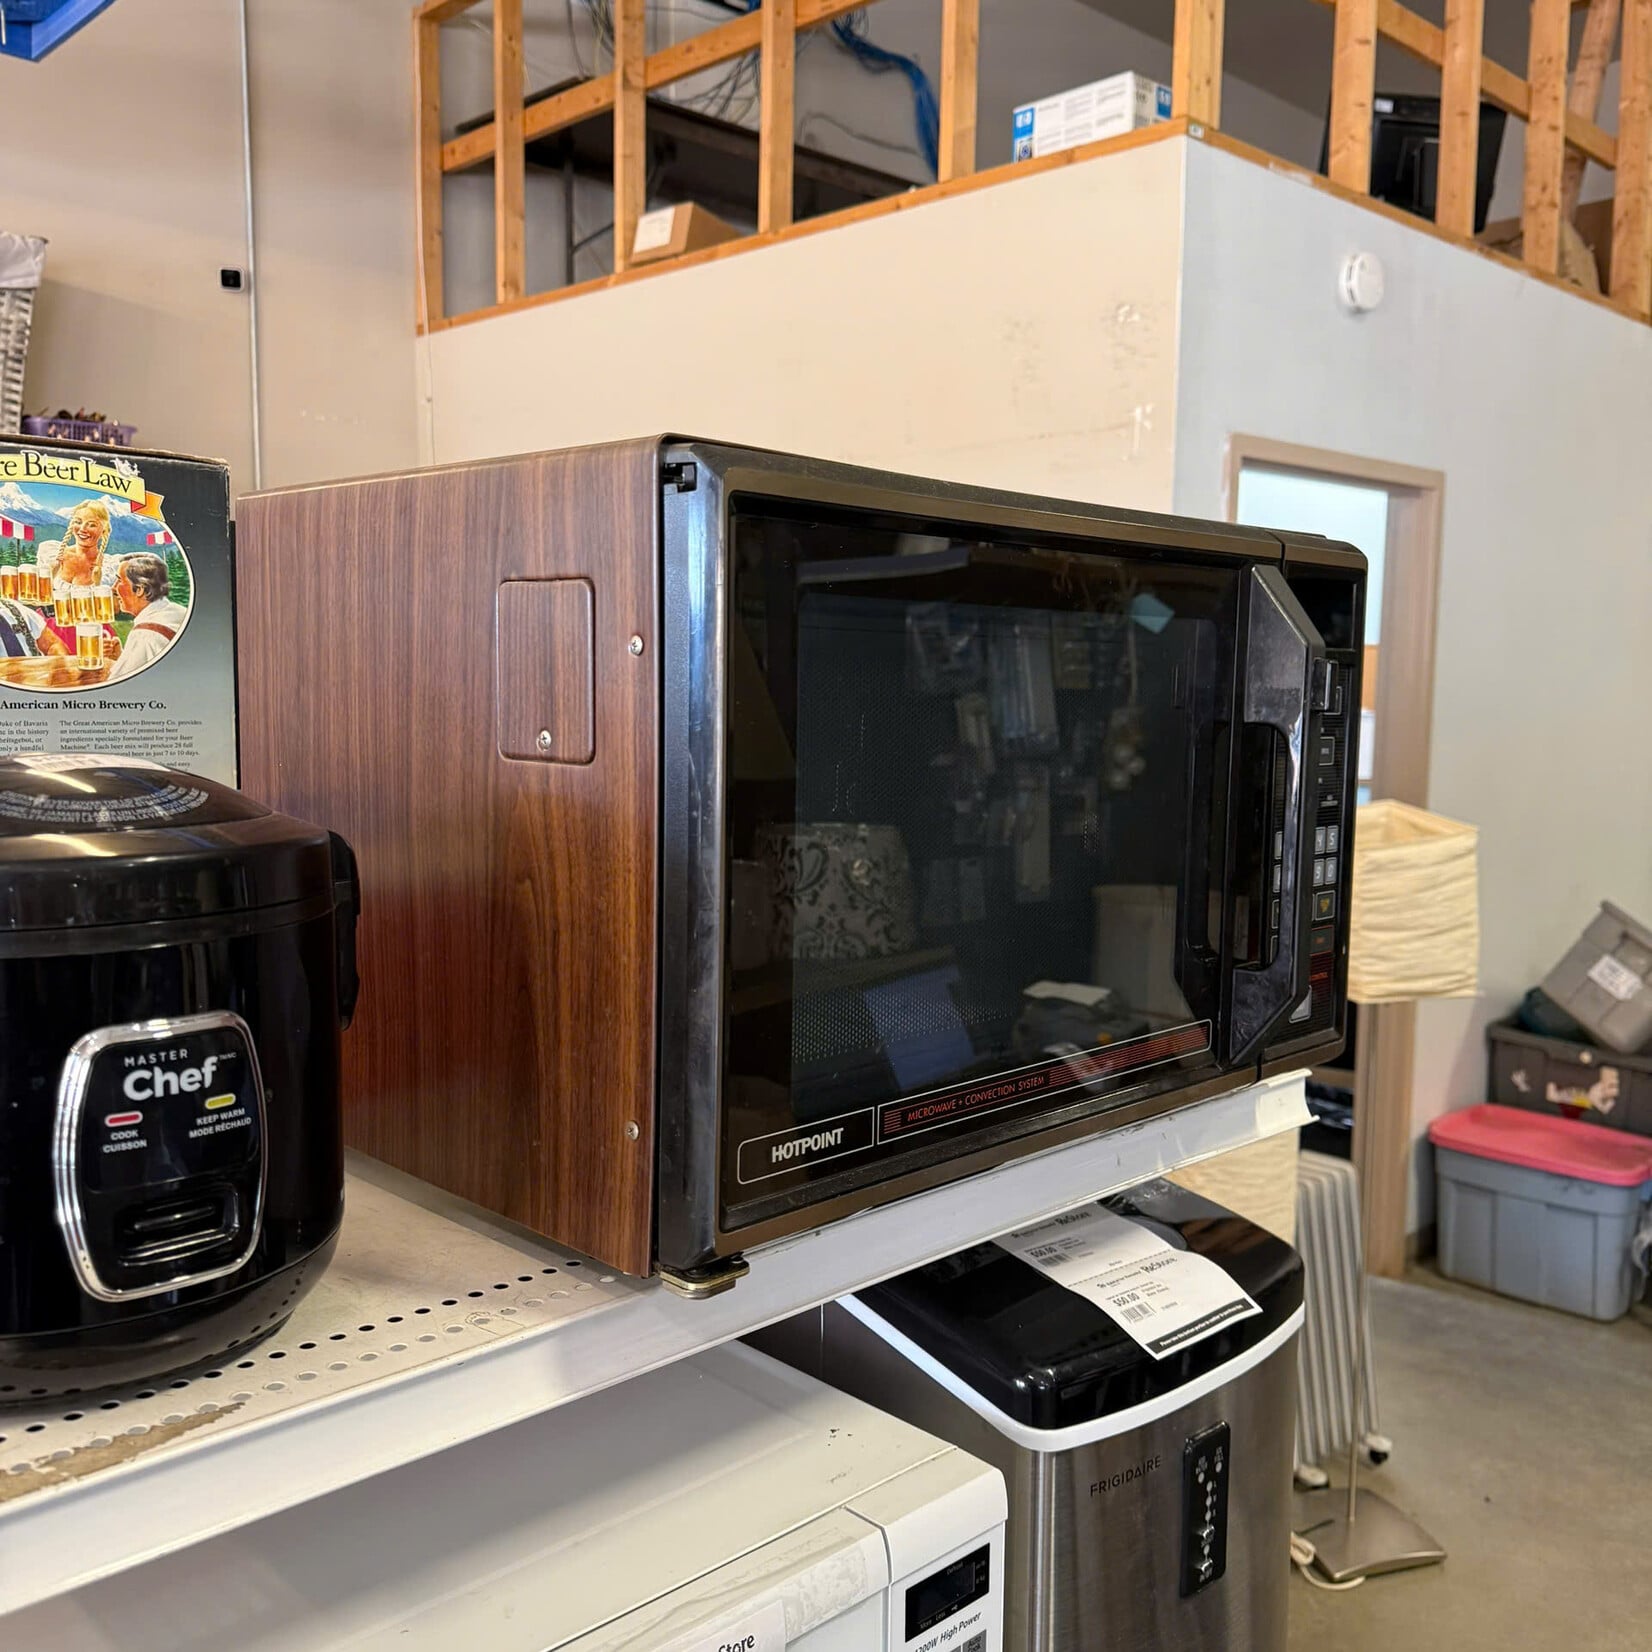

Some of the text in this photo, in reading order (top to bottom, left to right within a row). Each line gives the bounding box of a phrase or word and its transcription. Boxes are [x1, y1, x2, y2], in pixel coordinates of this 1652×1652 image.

[22, 451, 78, 481] Beer
[83, 460, 132, 493] Law
[0, 699, 167, 712] American Micro Brewery Co.
[27, 728, 49, 736] history
[94, 735, 121, 743] specially
[124, 1048, 188, 1068] MASTER
[123, 1056, 218, 1101] Chef
[907, 1099, 957, 1122] MICROWAVE
[964, 1083, 1016, 1106] CONVECTION
[1018, 1076, 1045, 1091] SYSTEM
[196, 1107, 246, 1126] KEEP WARM
[110, 1130, 139, 1140] COOK
[189, 1116, 252, 1139] MODE RÉCHAUD
[103, 1139, 148, 1154] CUISSON
[771, 1127, 844, 1163] HOTPOINT
[1089, 1455, 1161, 1497] FRIGIDAIRE
[940, 1624, 958, 1643] High
[959, 1611, 982, 1632] Power
